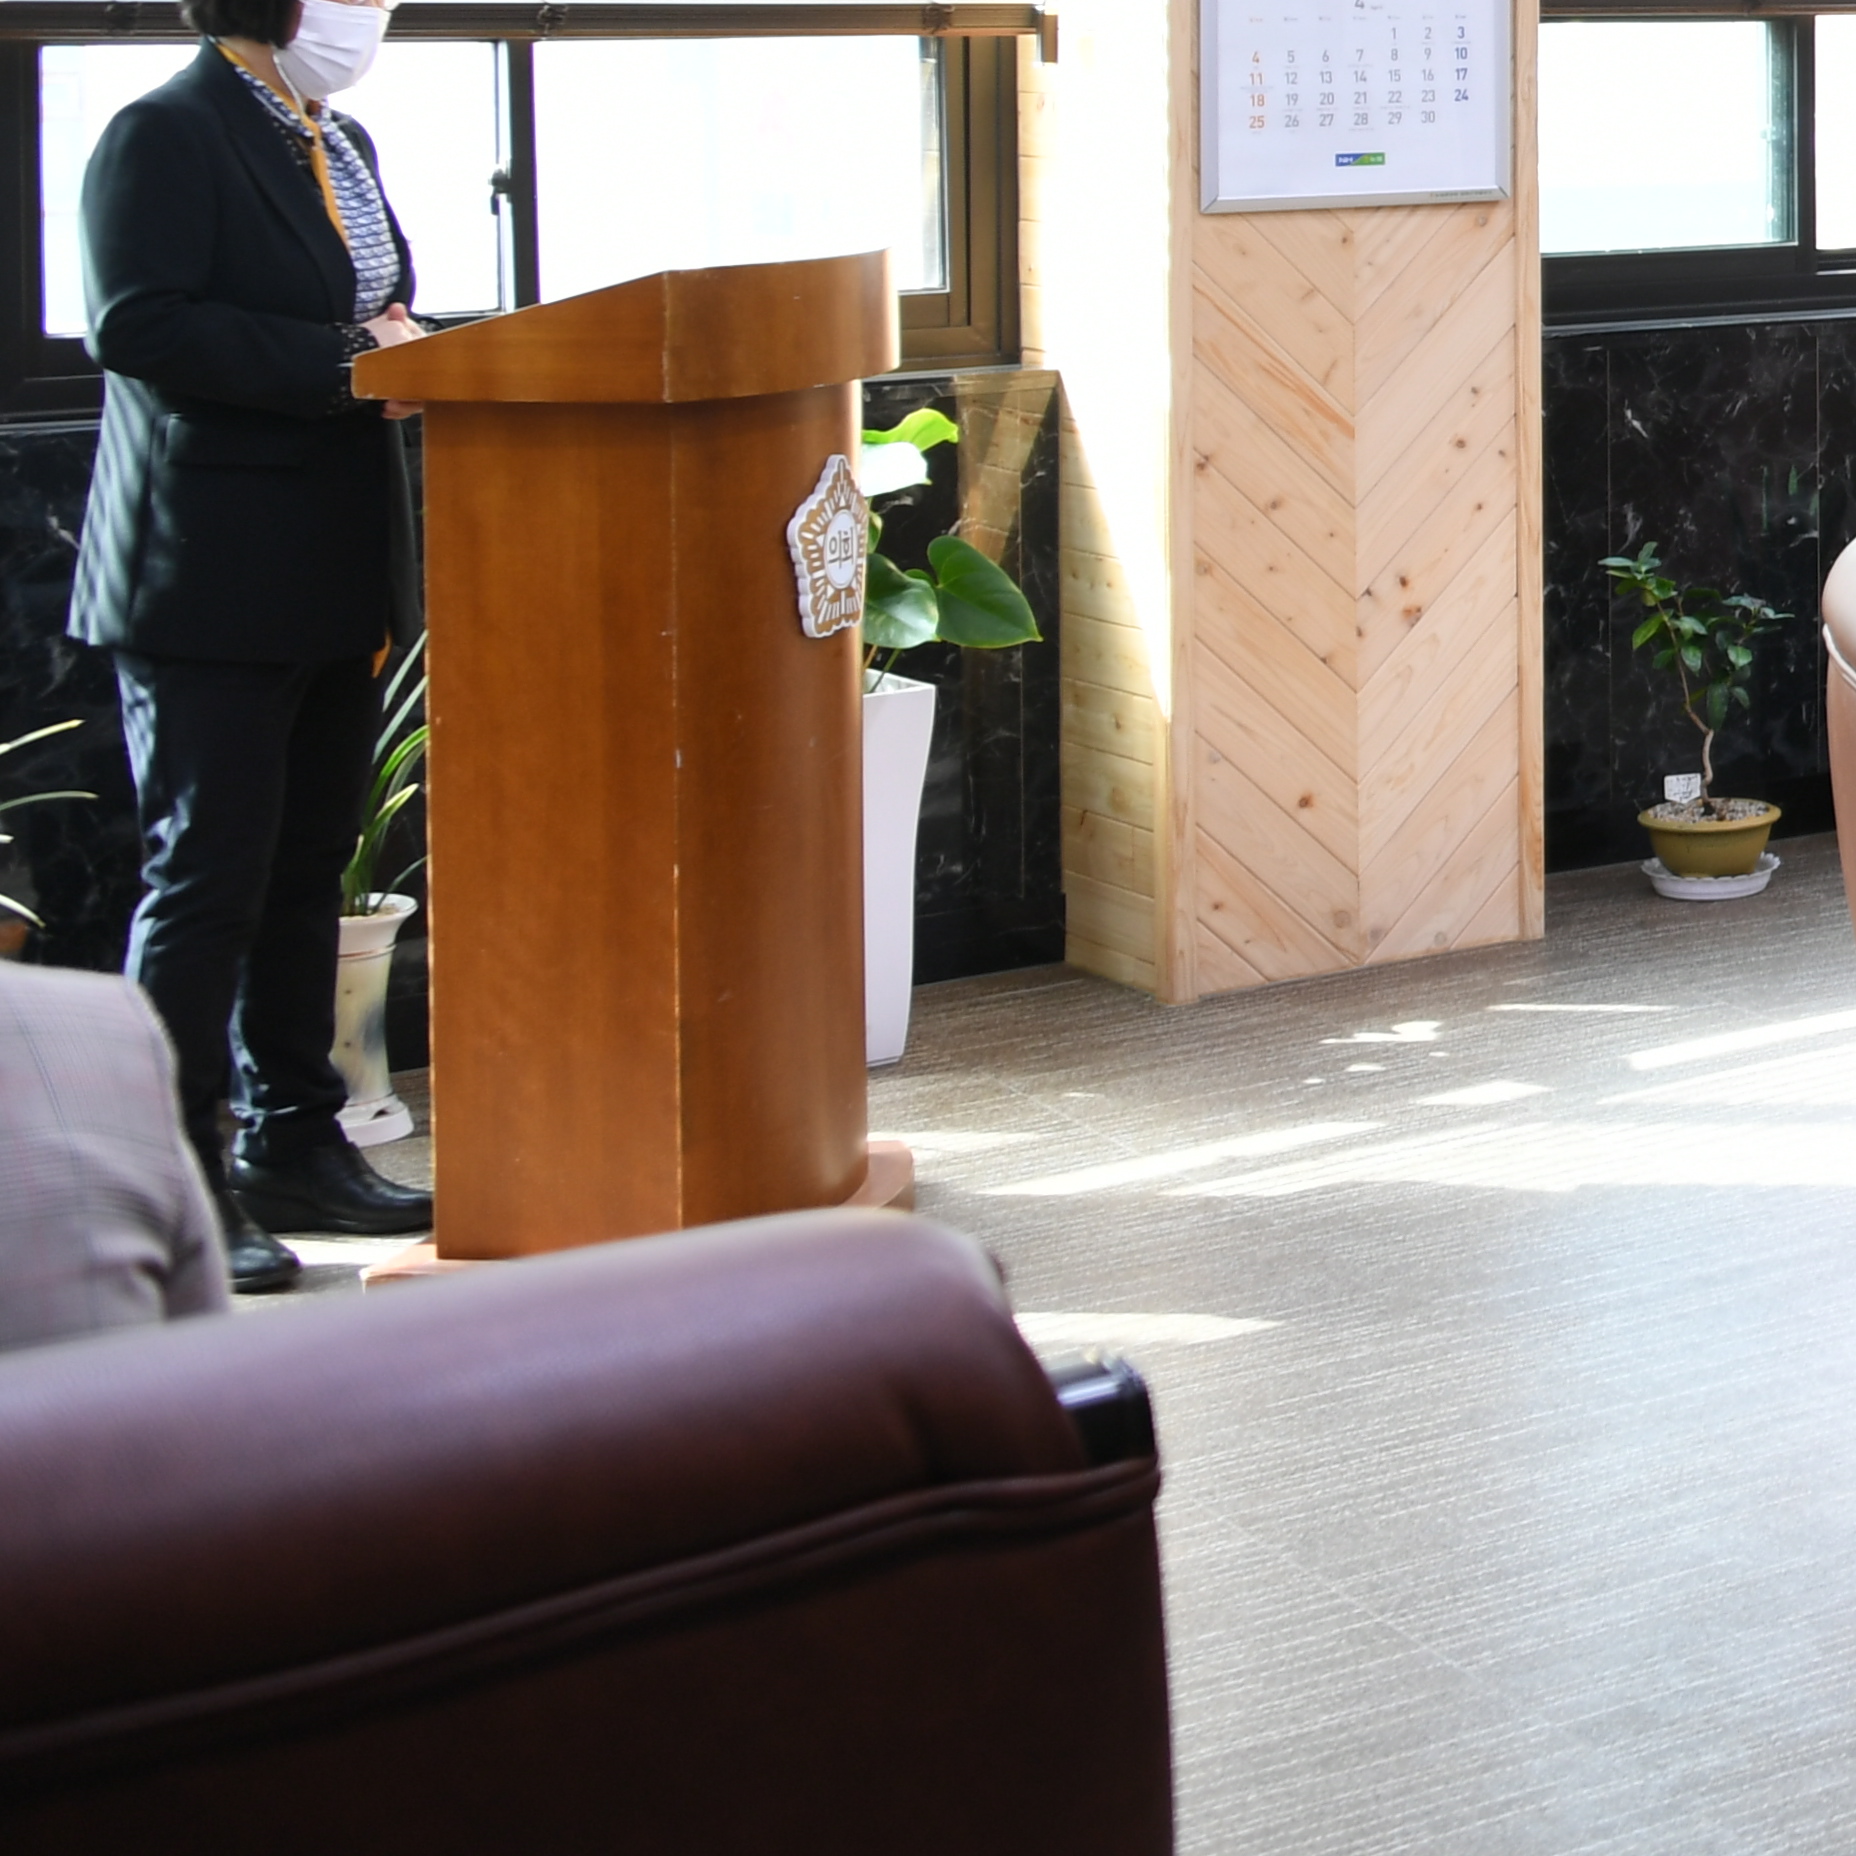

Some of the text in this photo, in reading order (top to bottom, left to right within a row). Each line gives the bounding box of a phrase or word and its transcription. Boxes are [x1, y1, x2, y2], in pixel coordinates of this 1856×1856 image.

[1391, 27, 1466, 39] 1 2 3
[1251, 47, 1467, 63] 4 5 6 7 8 9 10
[1250, 68, 1467, 85] 11 12 13 14 15 16 17
[1251, 89, 1468, 107] 18 19 20 21 22 23 24
[1249, 111, 1435, 128] 25 26 27 28 29 30
[828, 526, 855, 569] 의회
